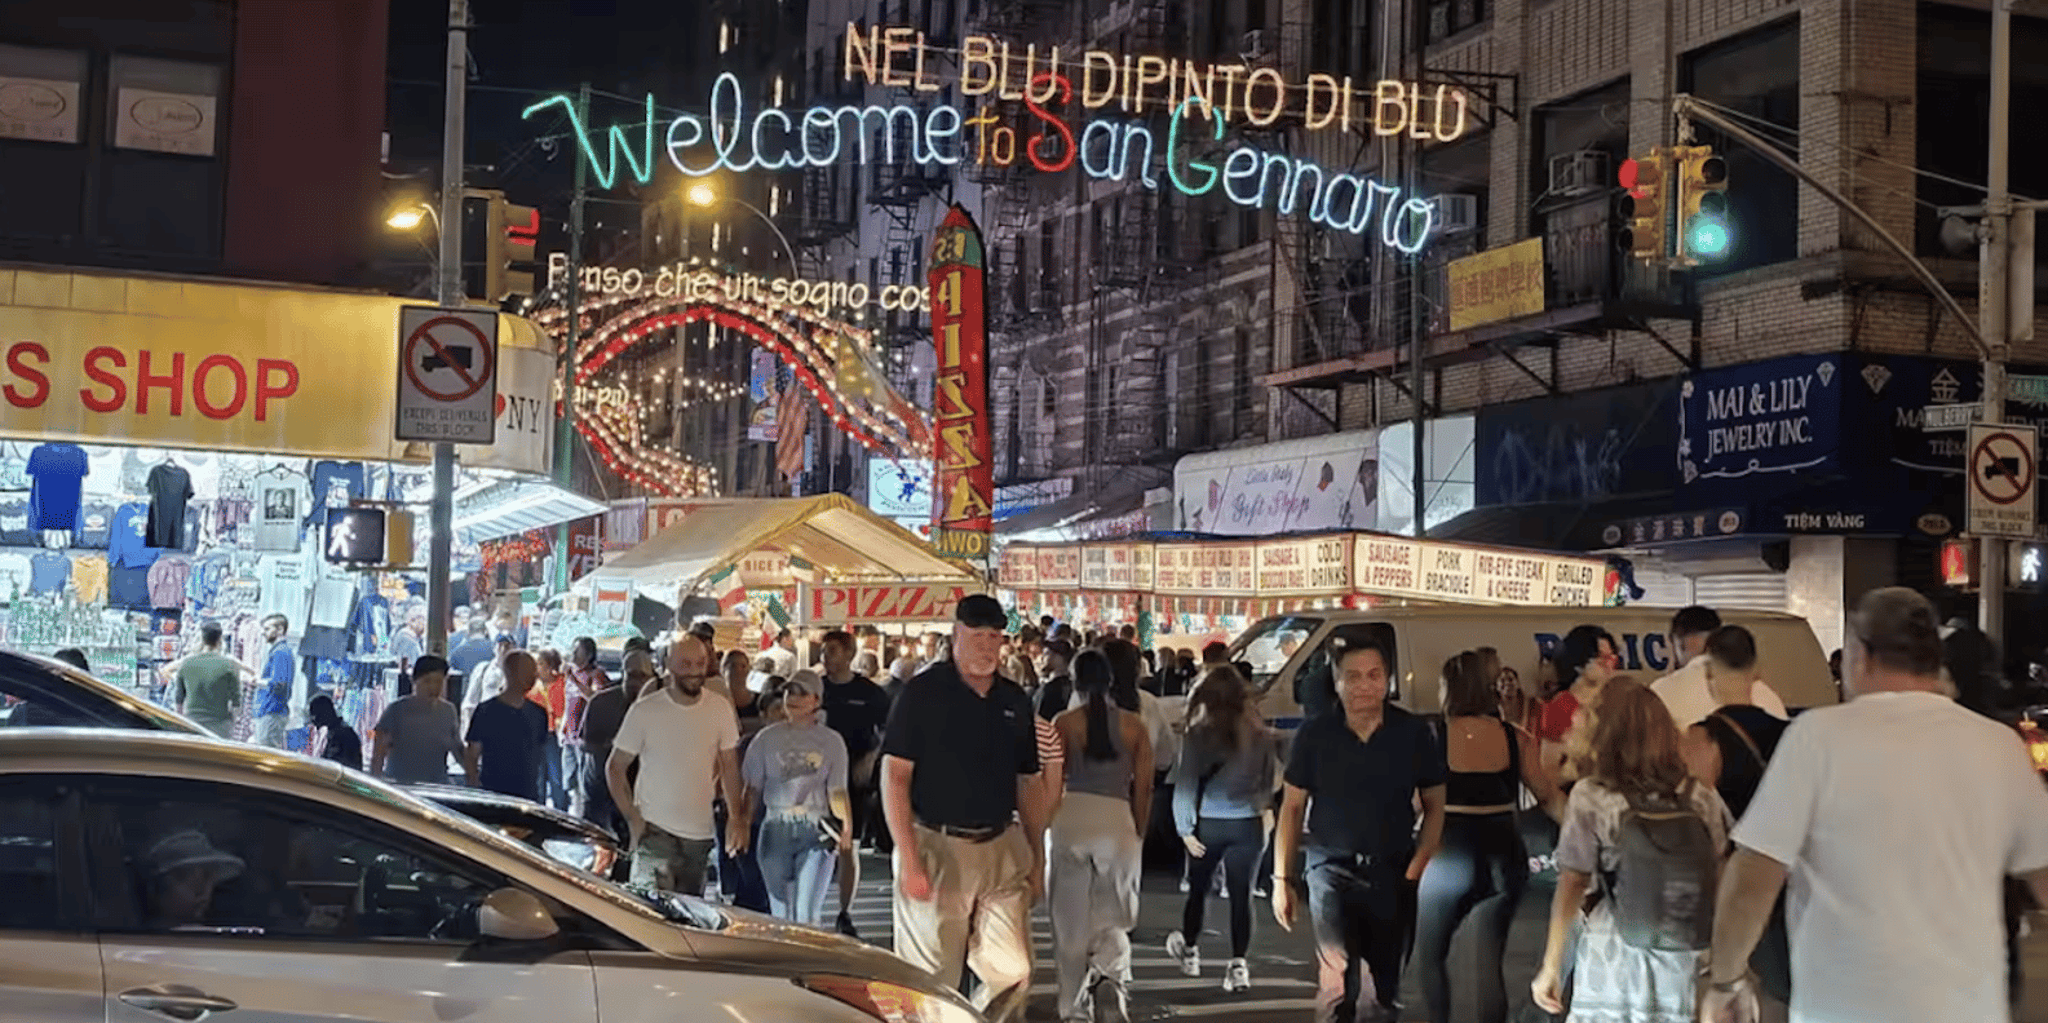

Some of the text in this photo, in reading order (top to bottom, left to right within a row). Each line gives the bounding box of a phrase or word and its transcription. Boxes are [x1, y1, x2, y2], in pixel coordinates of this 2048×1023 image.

[844, 22, 1466, 142] NEL BLU DIPINTO DI BLU
[522, 69, 1437, 254] Welcome to San Gennaro
[548, 252, 643, 295] Pnso
[654, 262, 718, 299] che
[724, 270, 758, 301] un
[770, 277, 869, 318] sogno
[79, 346, 300, 421] SHOP
[1707, 374, 1813, 421] MAI & LILY
[506, 394, 542, 434] NY
[1895, 407, 1926, 428] MA
[1704, 416, 1813, 463] JEWELRY INC.
[1232, 494, 1266, 525] Gift
[1267, 489, 1311, 521] Shop
[1318, 542, 1342, 563] COLD
[1368, 543, 1410, 566] SAUSAGE
[1436, 549, 1462, 571] PORK
[1478, 554, 1545, 581] RIB-EYE STEAK
[1312, 566, 1347, 587] DRINKS
[1372, 565, 1412, 588] PEPPERS
[1495, 579, 1531, 601] CHEESE
[1556, 563, 1593, 586] GRILLED
[811, 586, 966, 622] PIZZA
